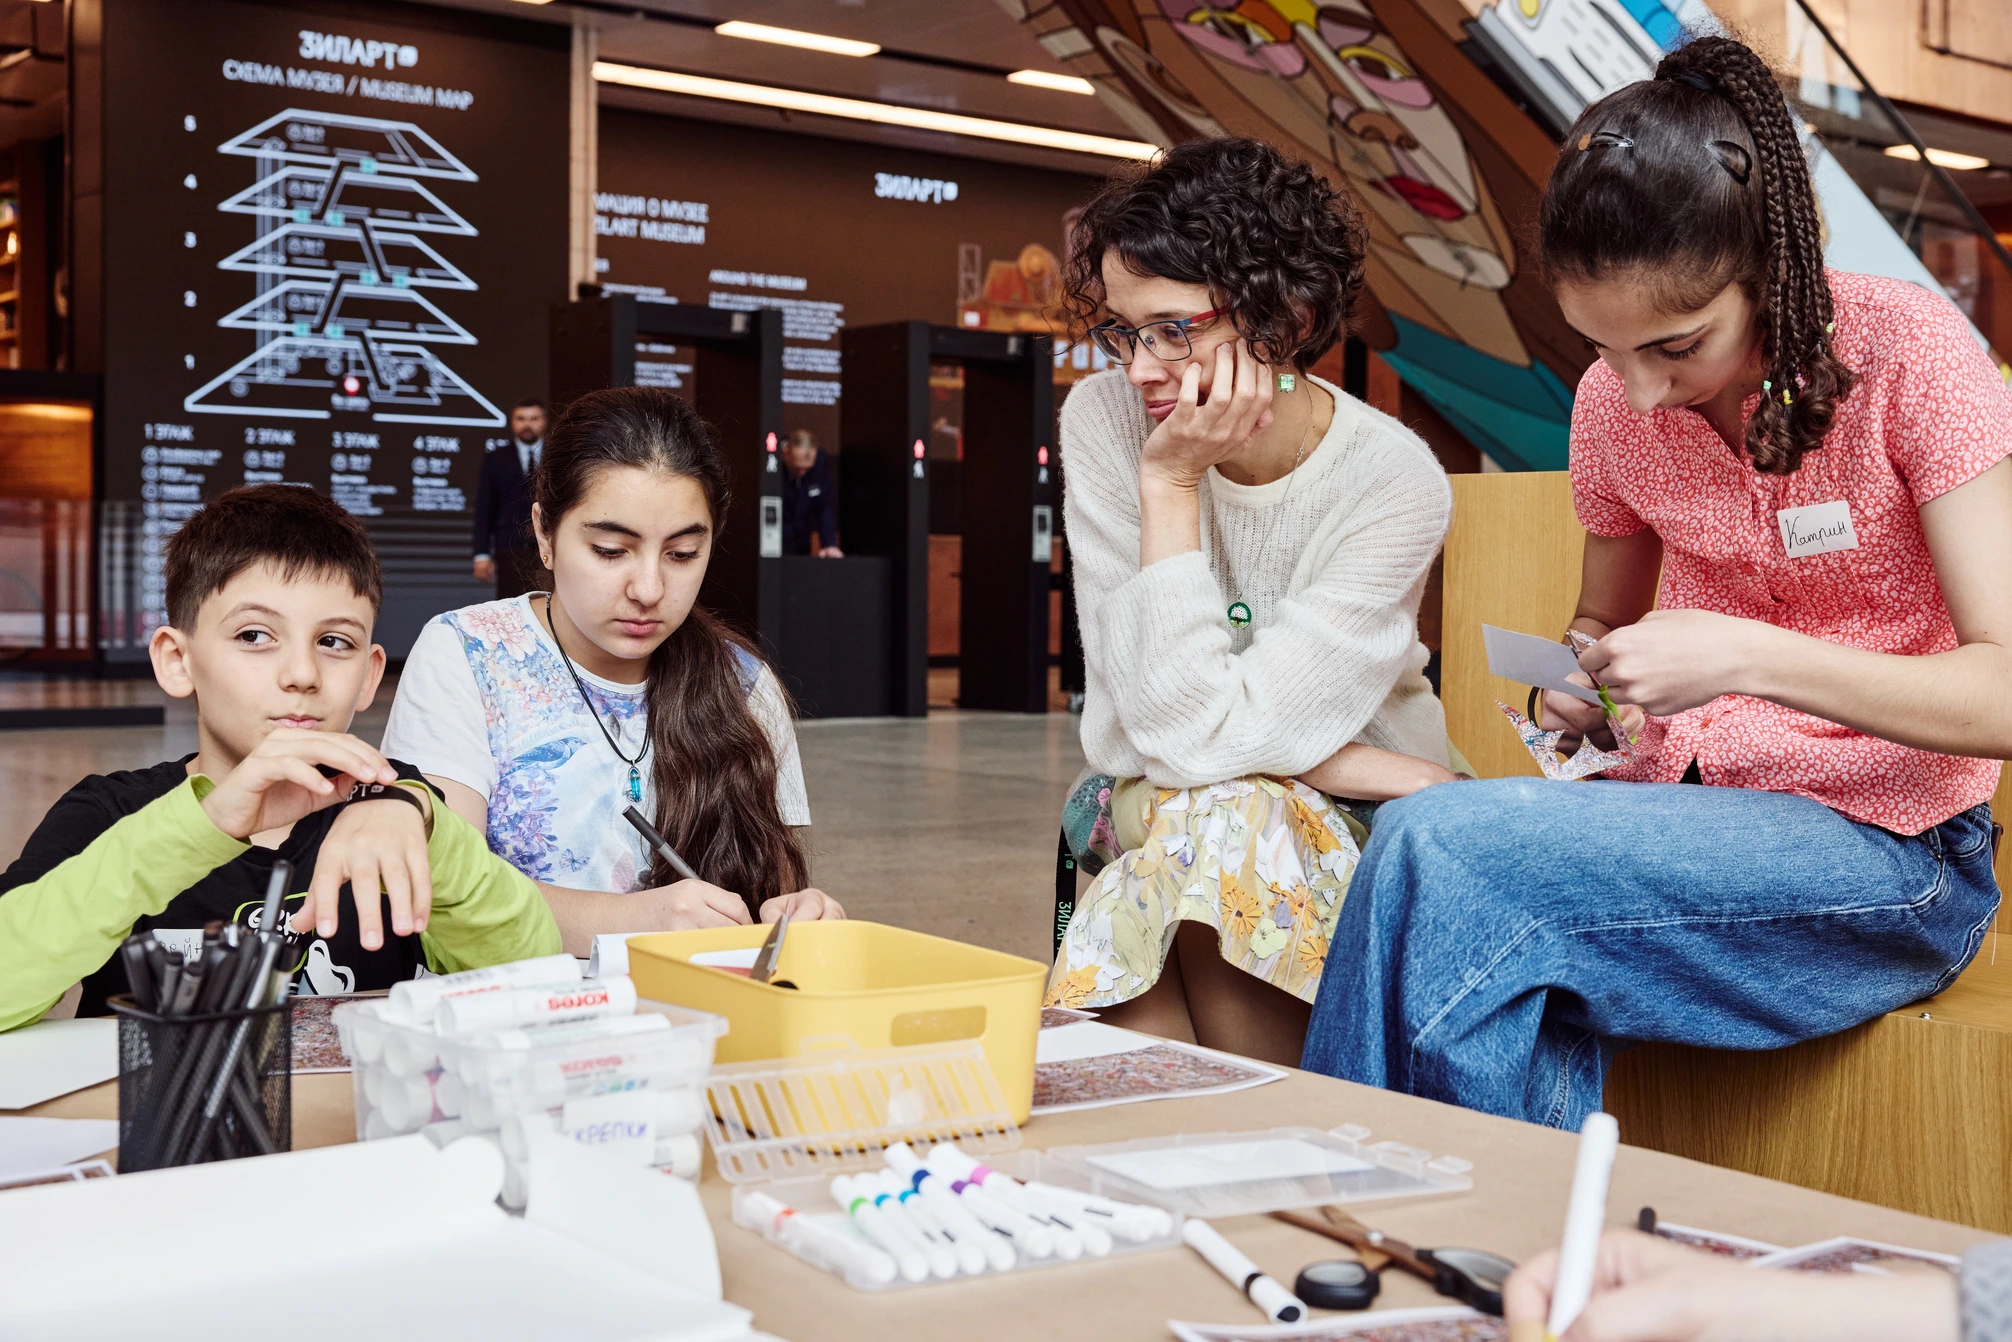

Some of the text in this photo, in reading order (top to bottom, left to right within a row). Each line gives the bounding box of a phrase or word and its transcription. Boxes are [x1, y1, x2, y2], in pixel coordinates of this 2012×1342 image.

[299, 29, 399, 70] ЗИЛАРТ
[222, 58, 285, 87] СХЕМА
[286, 66, 344, 94] МУЗЕЯ
[360, 77, 434, 106] MUSEUM
[435, 87, 474, 111] MAP
[874, 172, 943, 205] ЗИЛАРТ
[640, 219, 705, 245] MUSEUM
[766, 274, 807, 292] MUSEUM
[153, 423, 194, 442] ЭТАЖ
[256, 428, 296, 446] ЭТАЖ
[343, 431, 381, 450] ЭТАЖ
[425, 435, 461, 453] ЭТАЖ
[1784, 515, 1848, 550] Катрин
